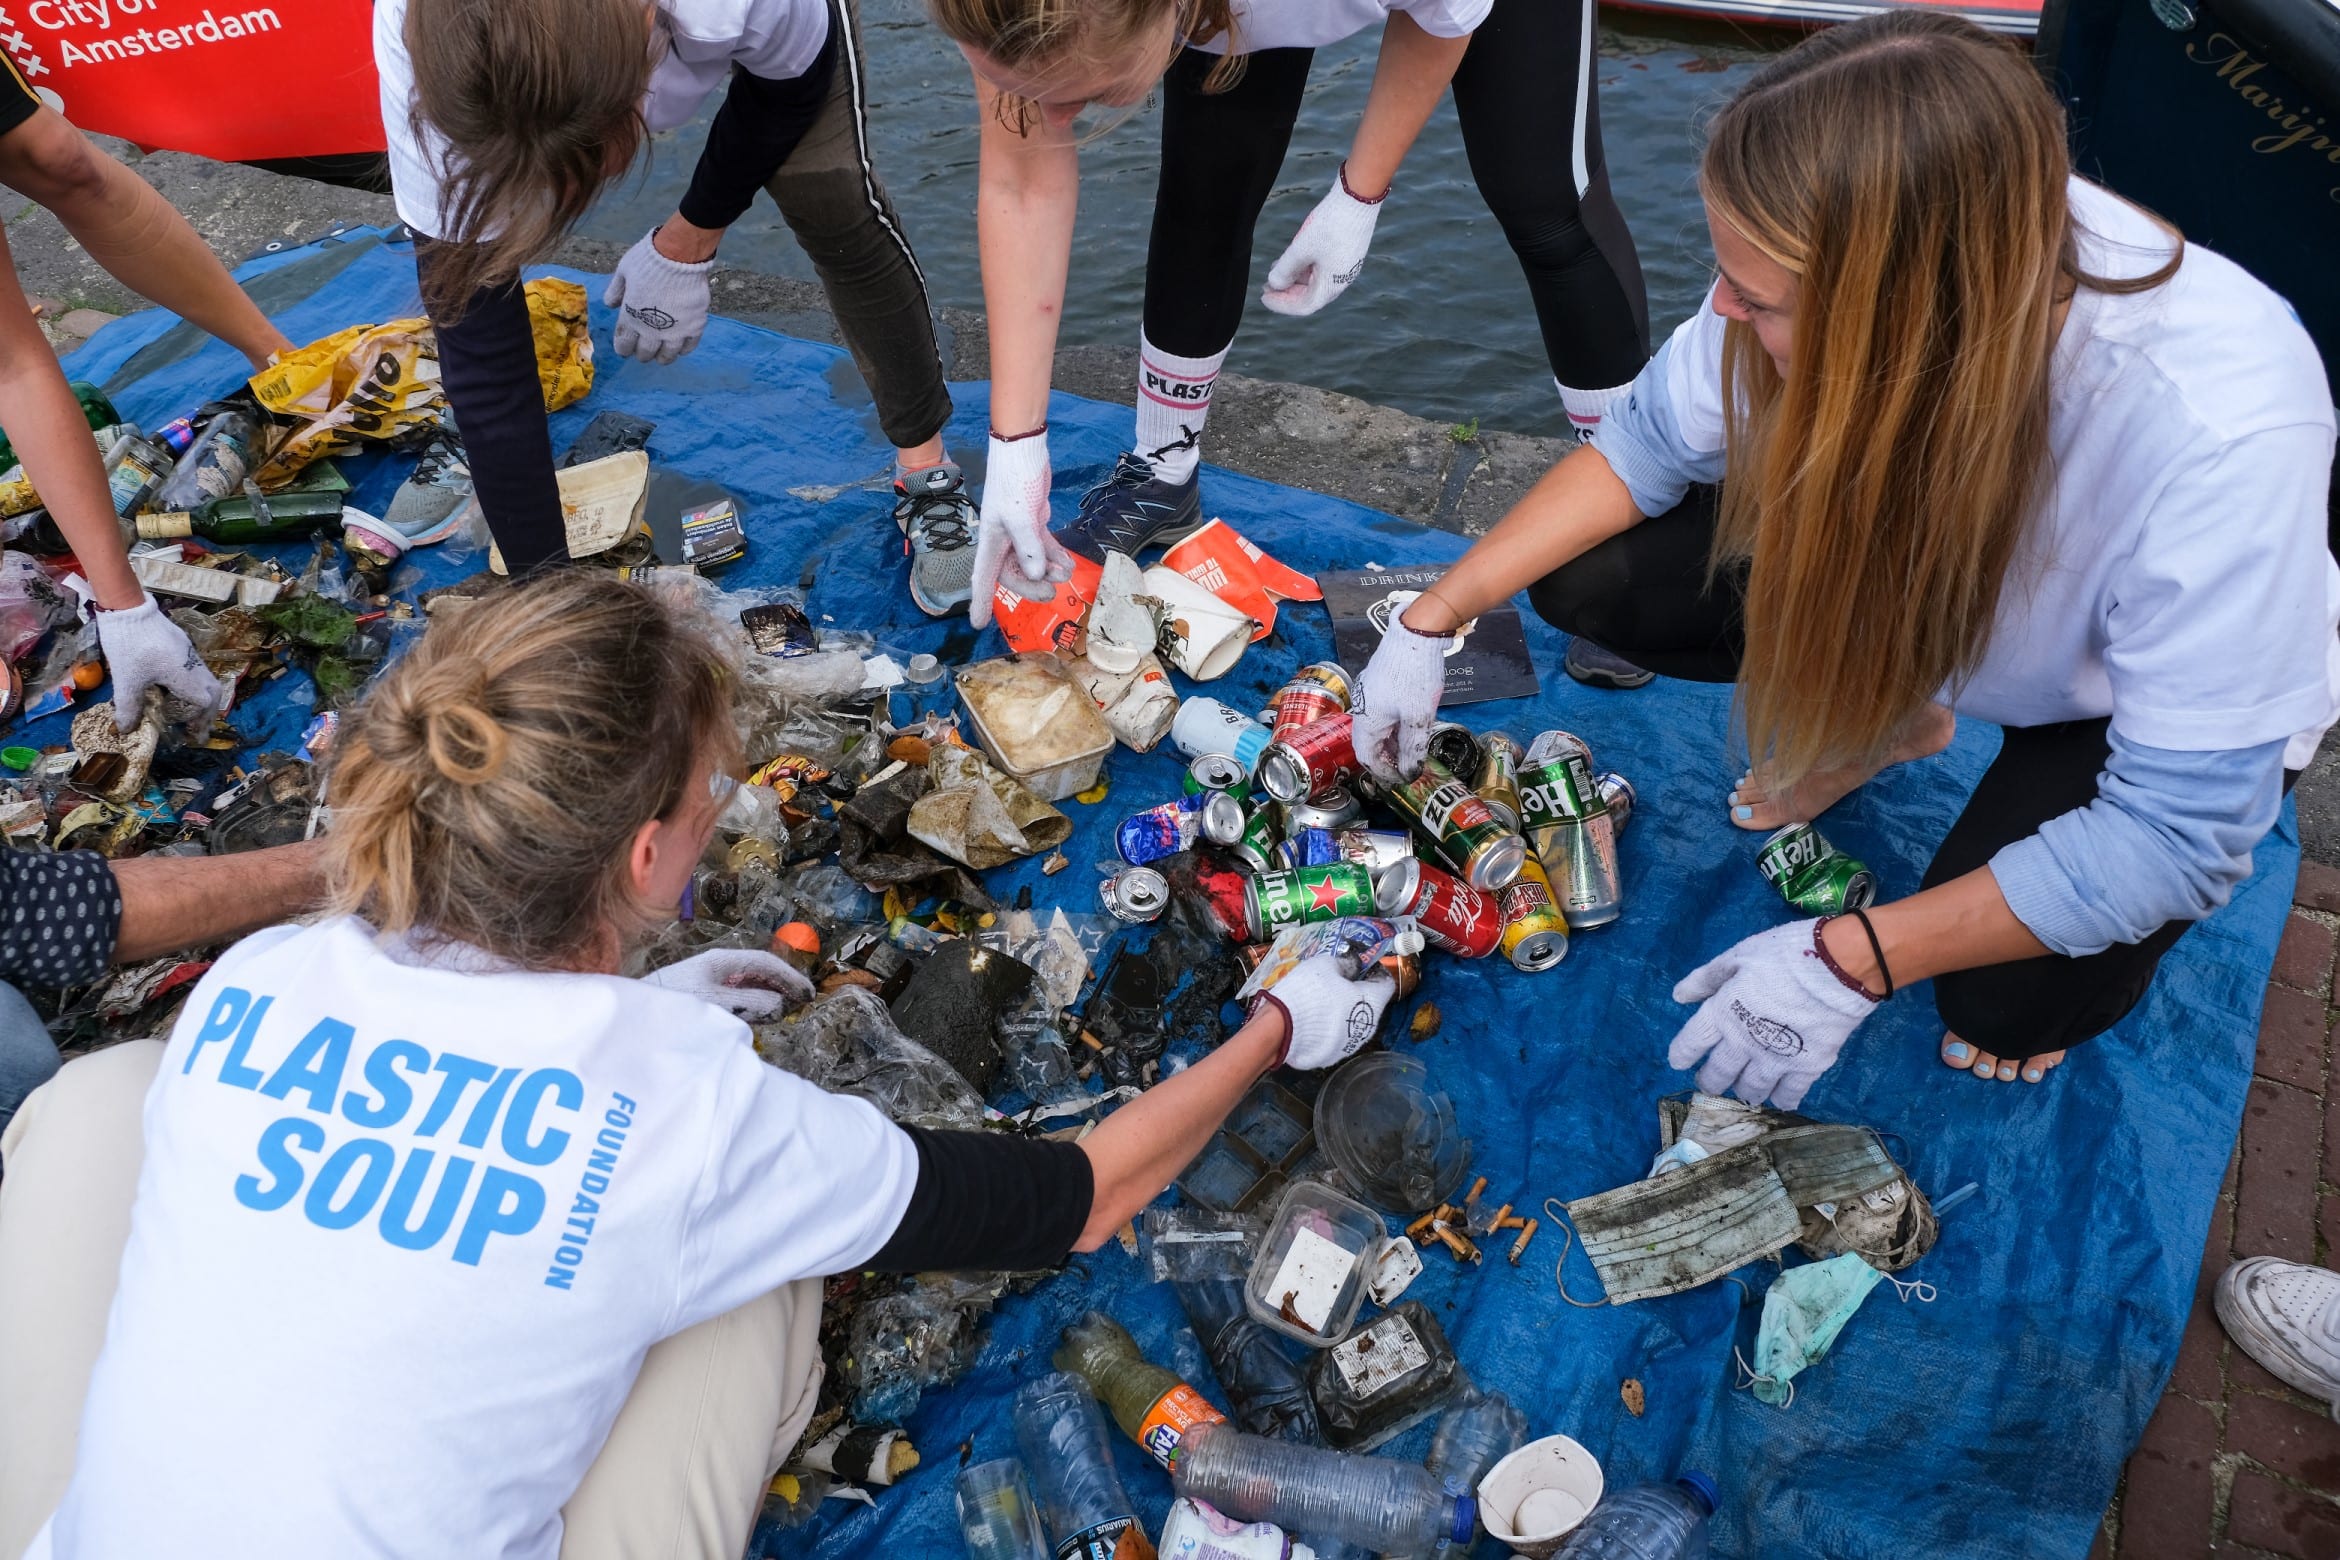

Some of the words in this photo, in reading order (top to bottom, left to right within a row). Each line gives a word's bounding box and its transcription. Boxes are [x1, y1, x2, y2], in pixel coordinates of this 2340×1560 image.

[29, 0, 111, 30] City
[60, 7, 281, 68] Amsterdam
[183, 986, 584, 1166] PLASTIC
[234, 1117, 546, 1266] SOUP
[544, 1091, 636, 1290] FOUNDATION
[1096, 1517, 1133, 1536] AQUARIUS
